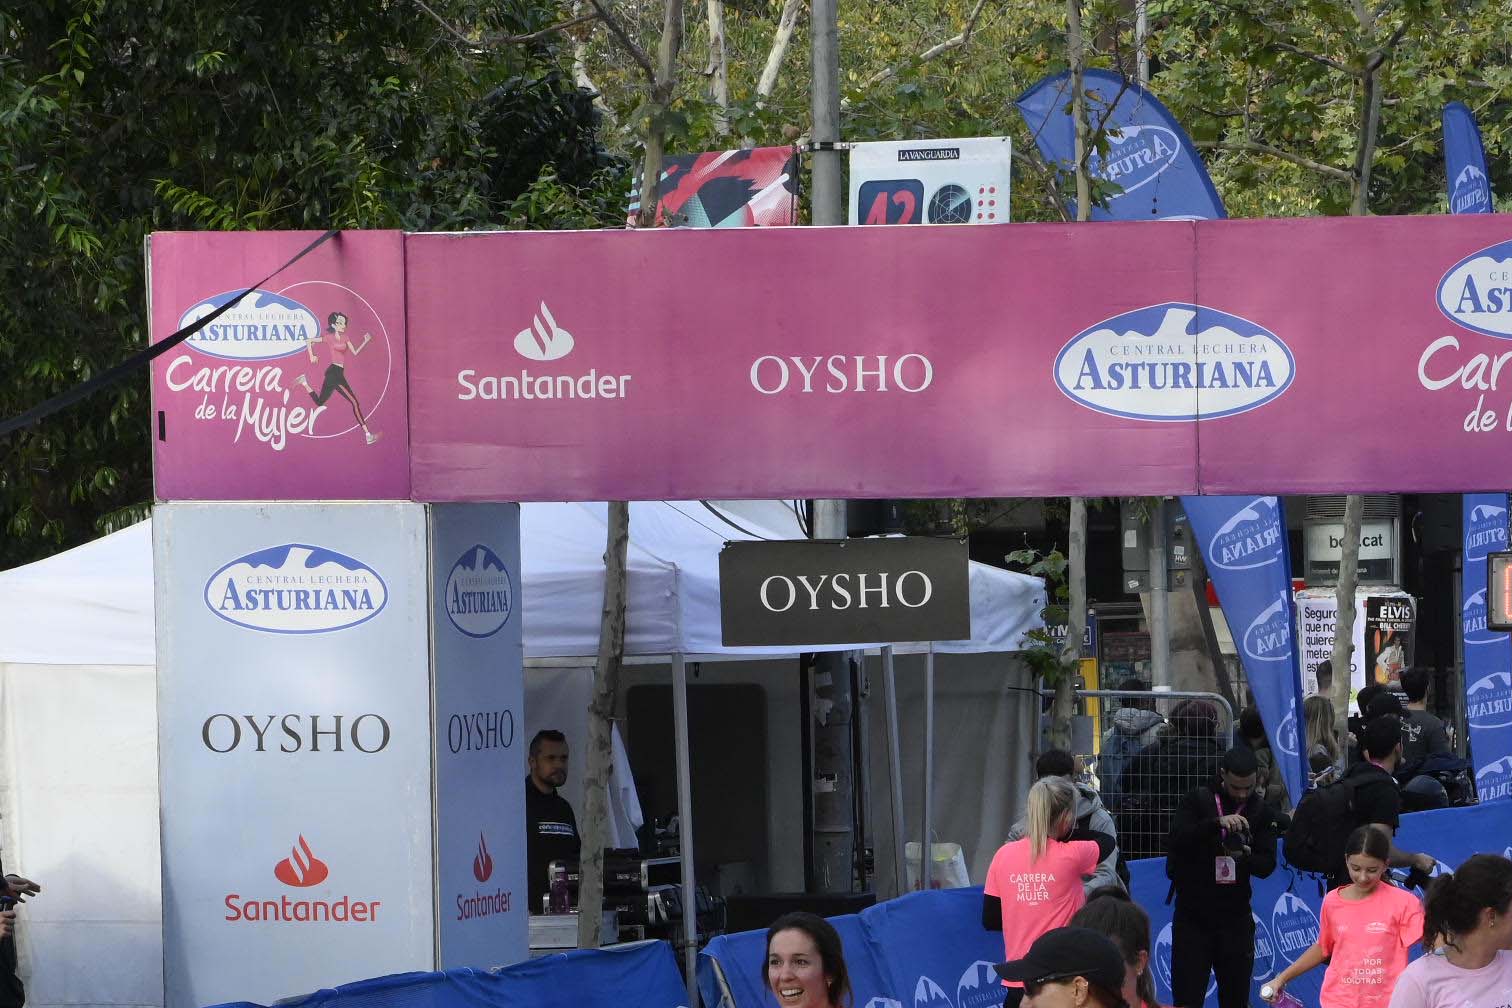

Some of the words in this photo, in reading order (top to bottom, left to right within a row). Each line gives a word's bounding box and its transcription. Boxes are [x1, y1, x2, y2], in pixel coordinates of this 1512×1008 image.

[190, 314, 308, 342] ASTURIANA
[216, 312, 252, 321] ENTRAL
[1110, 344, 1184, 355] CENTRAL
[1193, 343, 1267, 354] LECHERA
[166, 355, 283, 391] Carrera
[457, 368, 631, 400] Santander
[750, 353, 933, 394] OYSHO
[1073, 348, 1276, 391] ASTURIANA
[195, 395, 216, 420] de
[221, 393, 237, 420] la
[234, 391, 327, 450] Mujer
[1463, 395, 1497, 432] de
[219, 577, 374, 611] ASTURIANA
[246, 575, 304, 585] CENTRAL
[311, 575, 368, 584] LECHERA
[760, 570, 933, 612] OYSHO
[451, 580, 508, 614] ASTURIANA
[1379, 606, 1410, 618] ELVIS
[1305, 623, 1322, 632] que
[1306, 634, 1334, 648] quiere
[202, 713, 390, 753] OYSHO
[448, 709, 514, 754] OYSHO
[1009, 873, 1055, 884] CARRERA
[1017, 883, 1031, 892] DE
[1035, 882, 1046, 892] LA
[224, 893, 380, 922] Santander
[456, 888, 512, 921] Santander
[1016, 891, 1050, 901] MUJER
